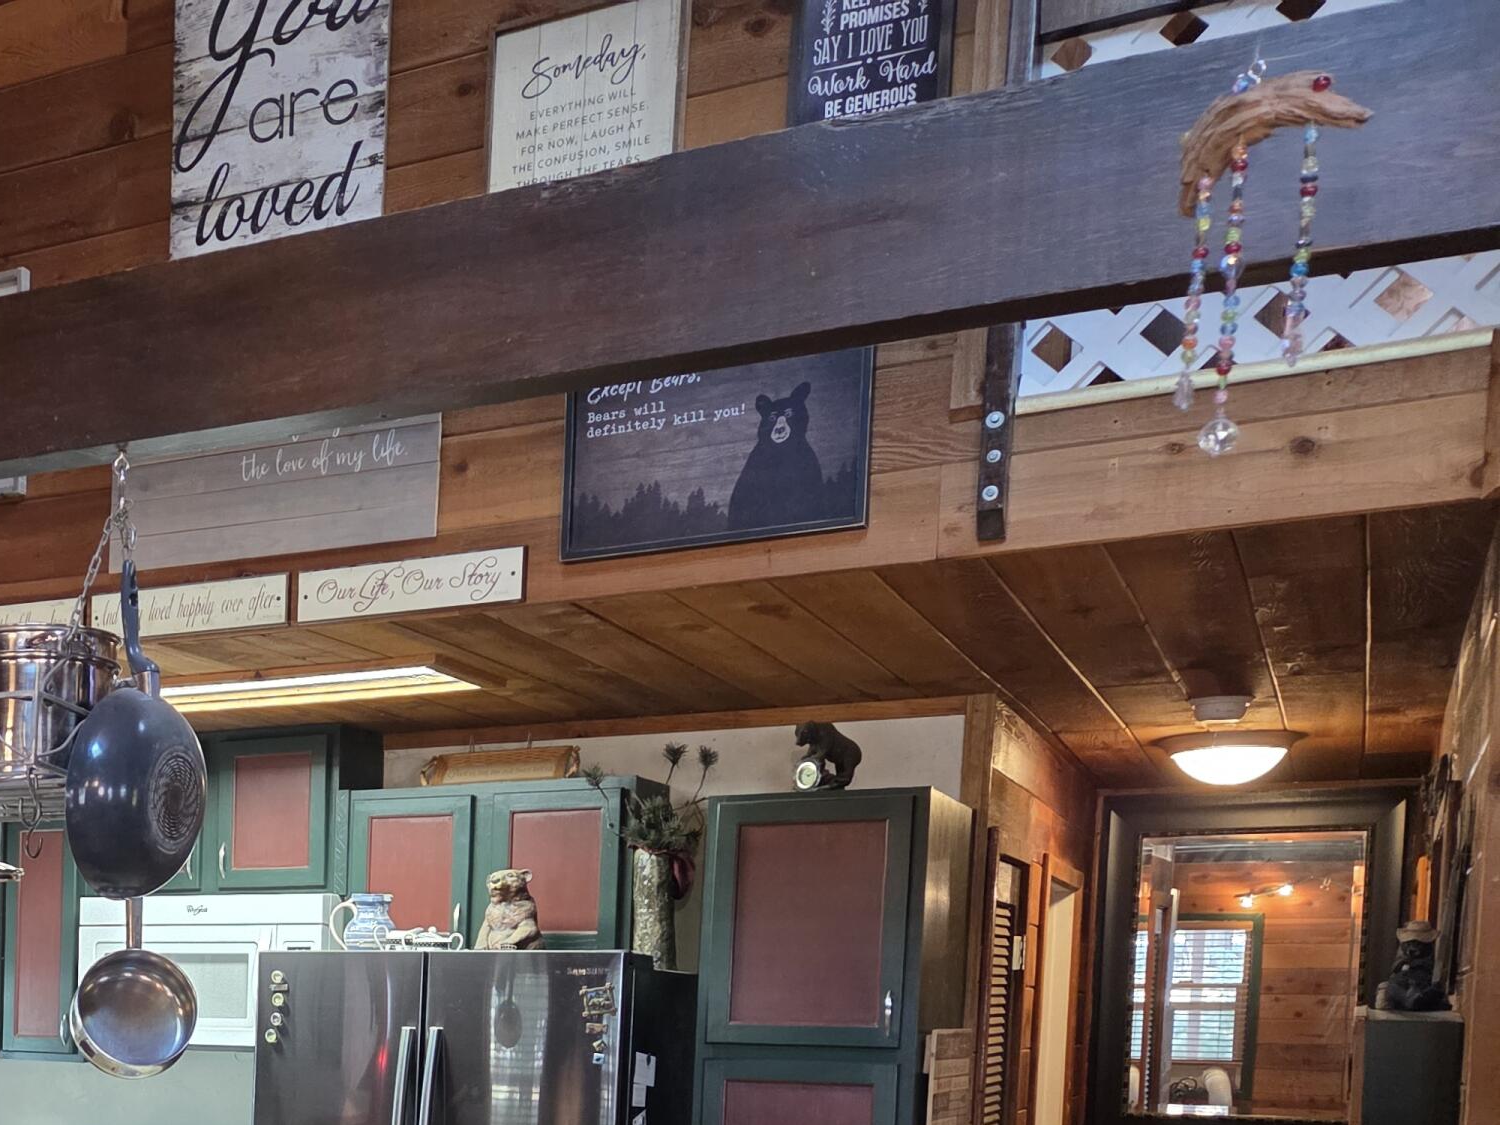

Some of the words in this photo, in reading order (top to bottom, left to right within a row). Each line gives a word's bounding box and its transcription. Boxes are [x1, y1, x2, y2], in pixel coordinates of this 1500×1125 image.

[840, 0, 911, 31] PROMISES
[813, 34, 842, 66] SAY
[847, 31, 854, 59] I
[859, 23, 894, 57] LOVE
[901, 14, 929, 47] YOU
[521, 33, 646, 99] Someday,
[807, 66, 871, 97] Work
[879, 50, 937, 84] Hard
[249, 78, 359, 142] are
[529, 94, 605, 121] EVERYTHING
[607, 87, 636, 102] WILL
[824, 98, 843, 119] BE
[845, 82, 918, 115] GENEROUS
[515, 124, 548, 141] MAKE
[552, 111, 603, 132] PERFECT
[520, 144, 544, 157] FOR
[547, 135, 579, 150] NOW,
[583, 125, 624, 142] LAUGH
[628, 119, 644, 131] AT
[512, 163, 533, 175] THE
[537, 145, 611, 170] CONFUSION,
[615, 134, 651, 151] SMILE
[195, 139, 364, 247] loved
[586, 416, 666, 438] definitely
[672, 409, 706, 426] kill
[713, 403, 746, 421] you!
[587, 409, 626, 424] Bears
[634, 401, 666, 416] will
[241, 452, 269, 482] the
[276, 448, 307, 476] love
[311, 438, 333, 476] of
[336, 449, 366, 473] my
[316, 578, 356, 604] Our
[401, 568, 444, 595] Our
[449, 555, 502, 601] Story
[148, 593, 175, 622] lived
[176, 589, 215, 628] happily
[220, 599, 243, 614] ever
